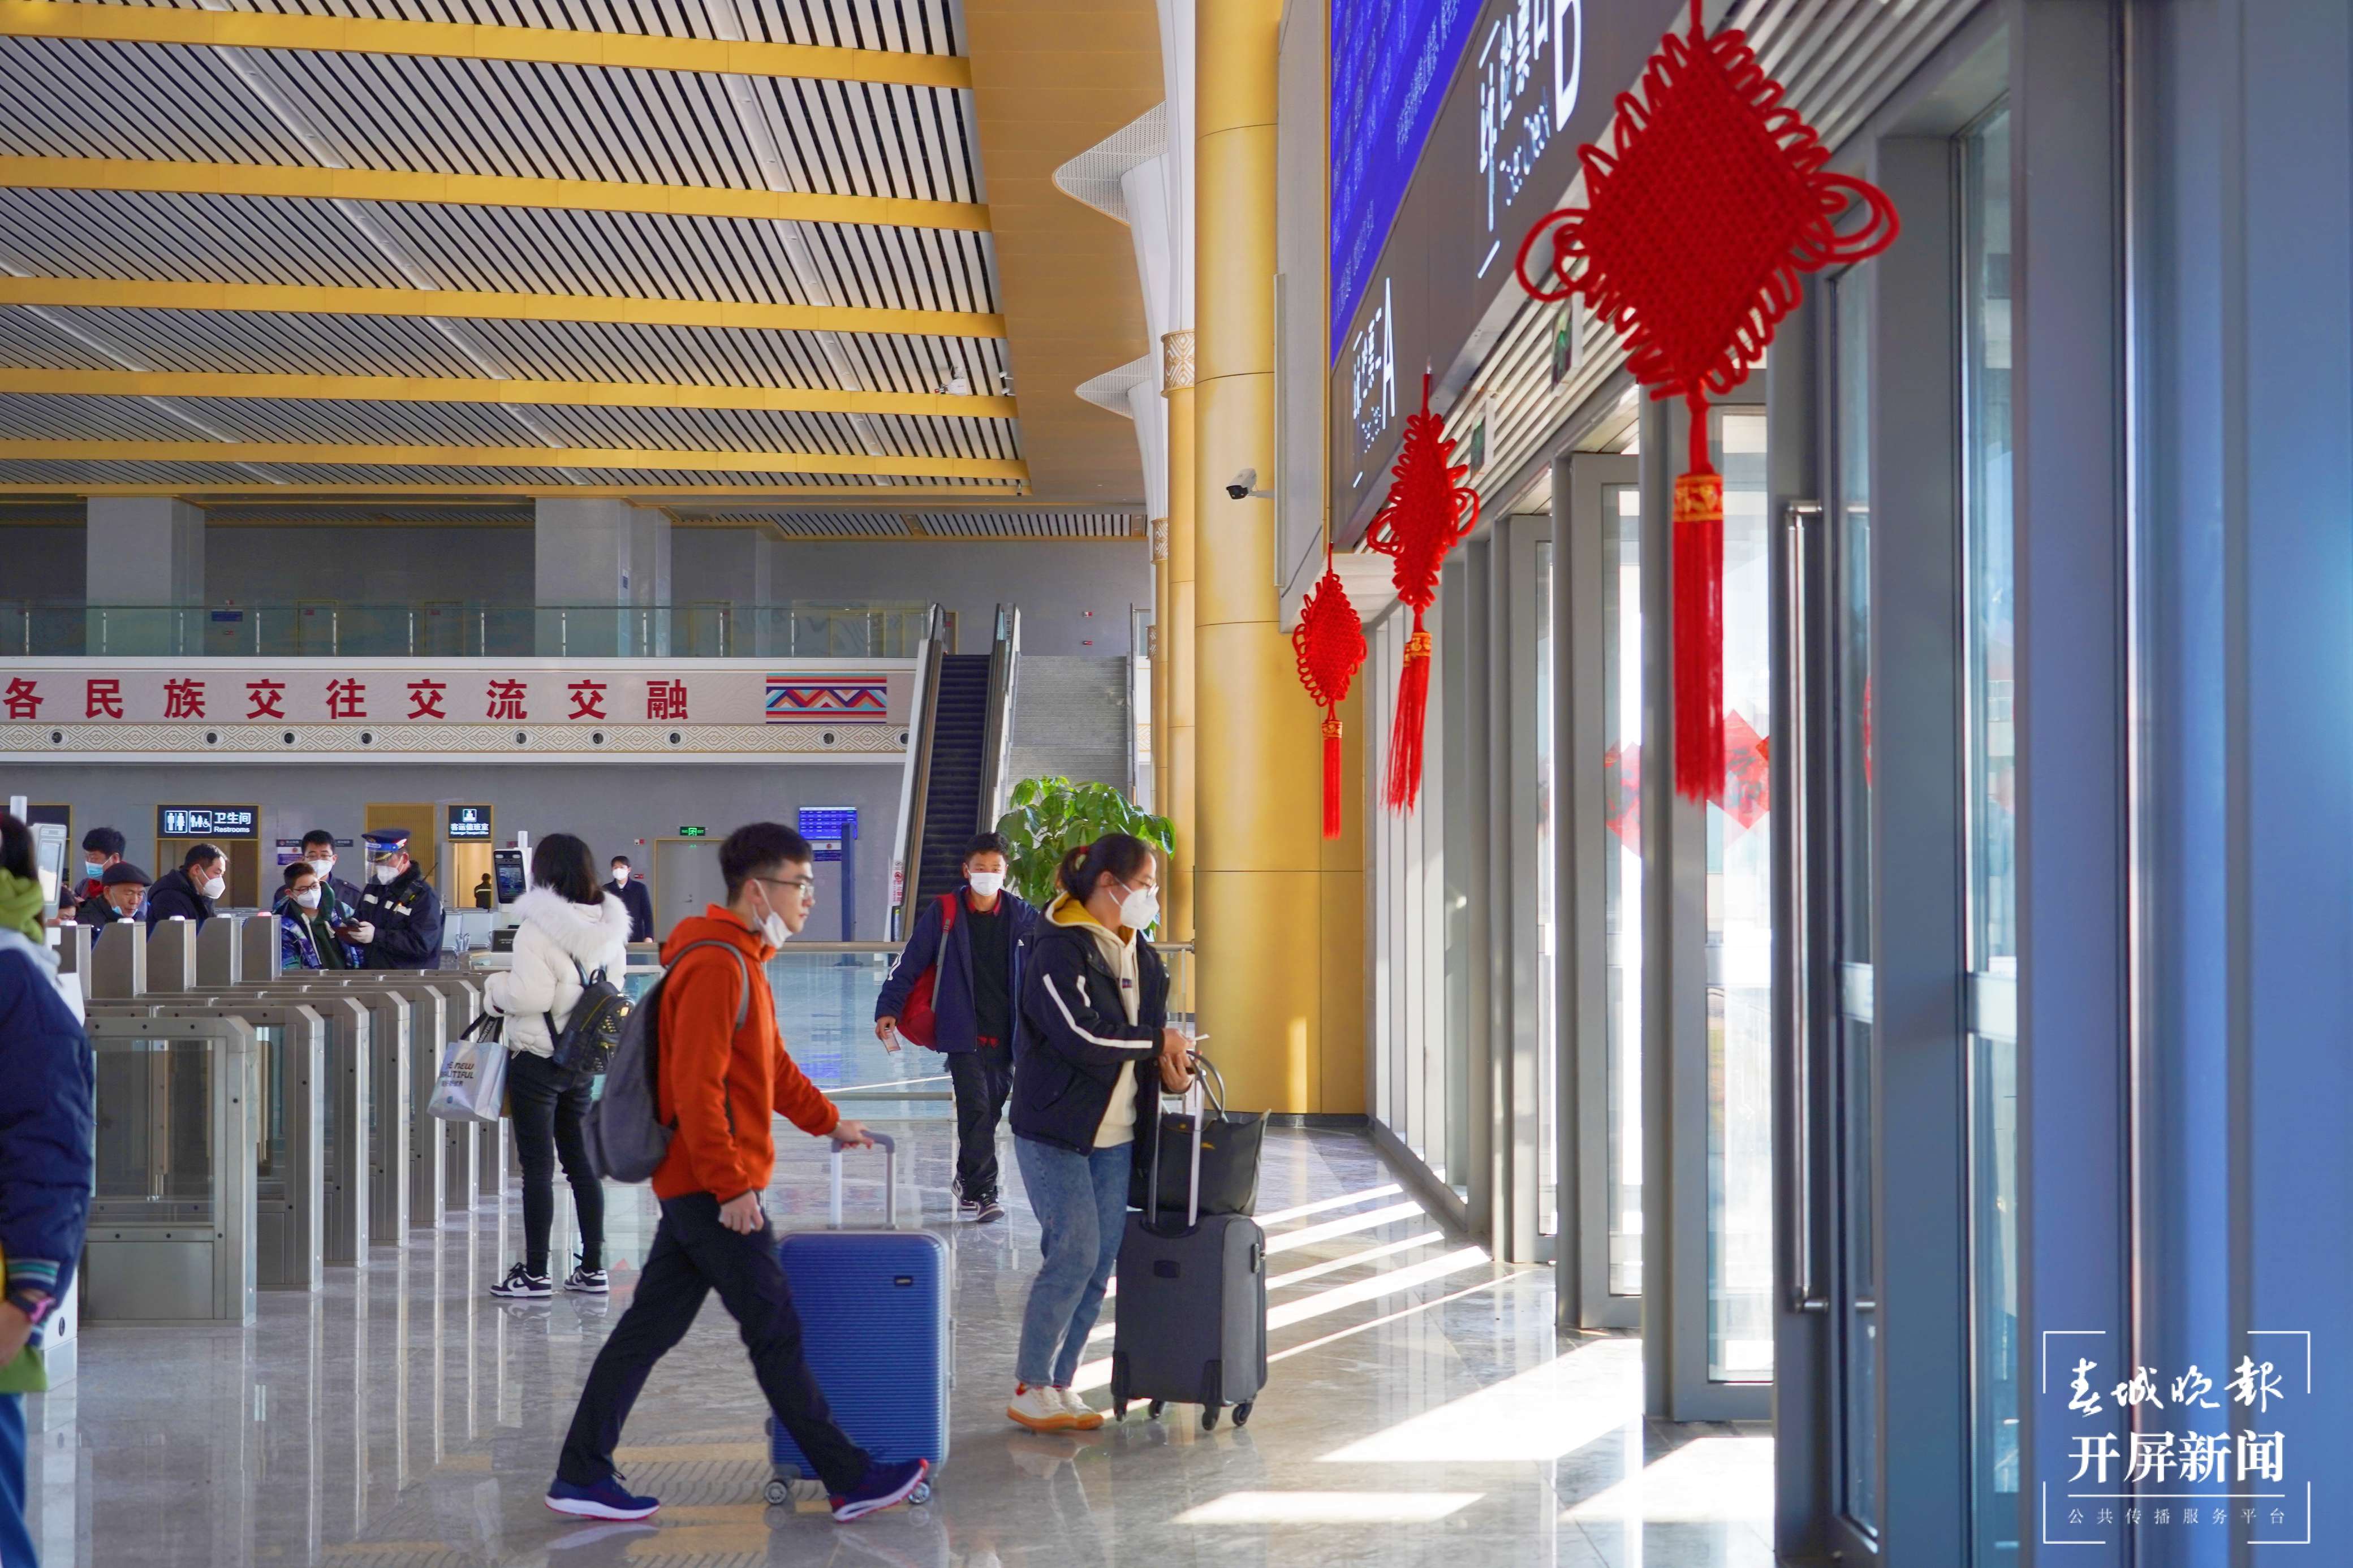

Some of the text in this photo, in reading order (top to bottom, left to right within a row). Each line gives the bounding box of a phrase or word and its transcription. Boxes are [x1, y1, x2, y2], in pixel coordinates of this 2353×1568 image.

[3, 678, 688, 720] 各民族交往交流交融
[214, 812, 251, 824] 卫生间
